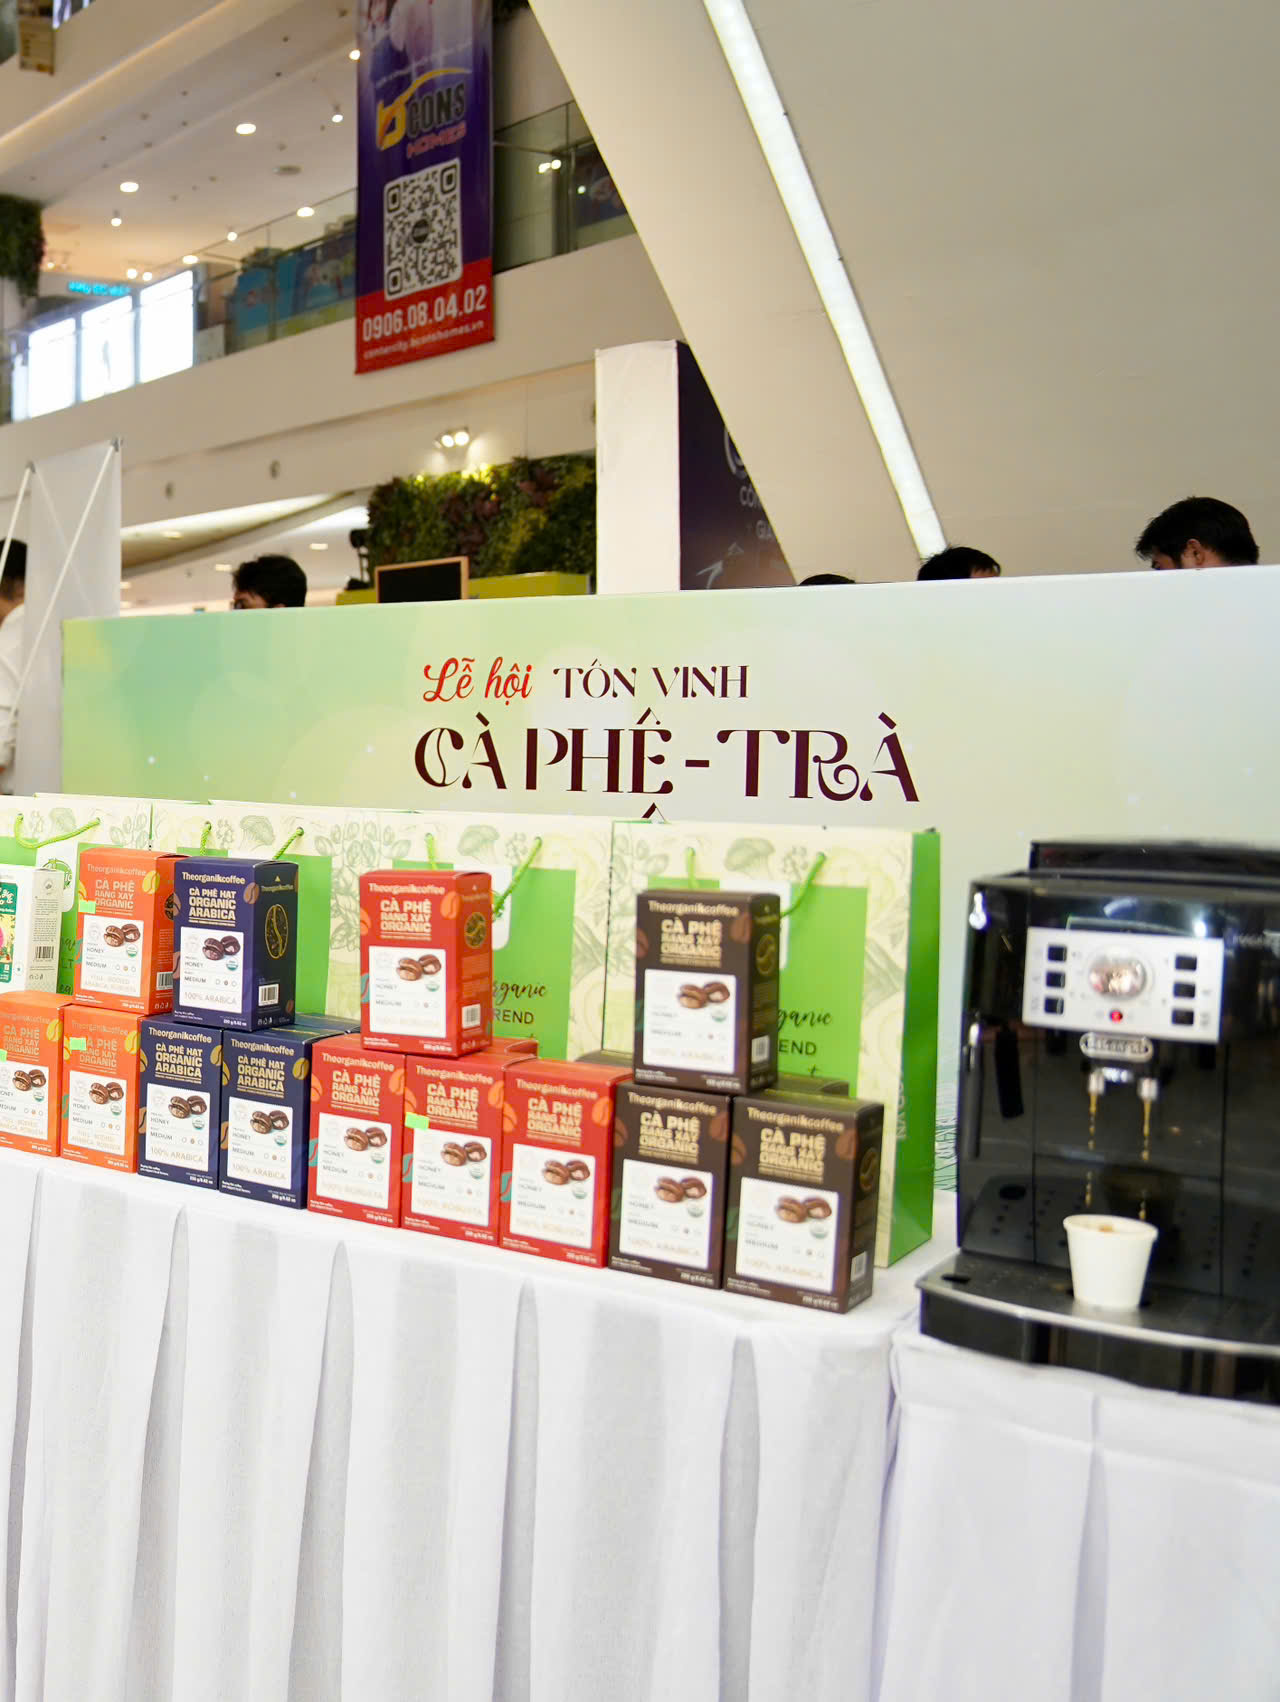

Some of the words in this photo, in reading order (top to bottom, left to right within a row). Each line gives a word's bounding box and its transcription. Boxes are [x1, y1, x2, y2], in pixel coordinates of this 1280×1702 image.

[363, 285, 487, 341] 0906.08.04.02
[423, 656, 475, 702] Lễ
[484, 656, 533, 706] hội
[553, 658, 638, 698] TÔN
[652, 665, 750, 698] VINH
[414, 711, 508, 789] CÀ
[182, 871, 246, 885] Theorganikcoffee
[189, 886, 200, 896] CÀ
[202, 887, 218, 897] PHÊ
[369, 883, 445, 895] Theorganikcoffee
[189, 896, 237, 909] ORGANIC
[380, 897, 400, 912] CÀ
[403, 899, 432, 913] PHÊ
[648, 900, 740, 917] Theorganikcoffee
[189, 906, 236, 920] ARABICA
[381, 912, 408, 922] RANG
[410, 913, 431, 923] XAY
[380, 920, 432, 933] ORGANIC
[148, 1027, 212, 1043] Theorganikcoffee
[101, 1050, 118, 1060] XAY
[155, 1042, 167, 1052] CÀ
[168, 1043, 184, 1054] PHÊ
[230, 1038, 295, 1056] Theorganikcoffee
[80, 1055, 117, 1068] ORGANIC
[155, 1052, 203, 1067] ORGANIC
[237, 1054, 249, 1065] CÀ
[250, 1055, 267, 1067] PHÊ
[322, 1053, 395, 1072] Theorganikcoffee
[155, 1062, 202, 1077] ARABICA
[237, 1064, 285, 1081] ORGANIC
[416, 1065, 493, 1084] Theorganikcoffee
[237, 1075, 284, 1092] ARABICA
[332, 1069, 350, 1084] CÀ
[354, 1071, 381, 1088] PHÊ
[332, 1084, 359, 1095] RANG
[360, 1087, 380, 1097] XAY
[427, 1082, 447, 1096] CÀ
[450, 1085, 479, 1101] PHÊ
[516, 1078, 598, 1099] Theorganikcoffee
[332, 1091, 380, 1107] ORGANIC
[427, 1095, 455, 1106] RANG
[457, 1099, 478, 1110] XAY
[528, 1096, 549, 1112] CÀ
[552, 1100, 583, 1117] PHÊ
[628, 1091, 717, 1116] Theorganikcoffee
[72, 1116, 93, 1125] MEDIUM
[427, 1104, 478, 1121] ORGANIC
[527, 1111, 558, 1122] RANG
[559, 1114, 582, 1126] XAY
[747, 1107, 844, 1133] Theorganikcoffee
[150, 1117, 169, 1125] HONEY
[527, 1120, 582, 1138] ORGANIC
[640, 1110, 664, 1128] CÀ
[667, 1115, 701, 1133] PHÊ
[150, 1131, 173, 1140] MEDIUM
[640, 1126, 673, 1139] RANG
[674, 1130, 699, 1143] XAY
[760, 1126, 786, 1145] CÀ
[789, 1132, 827, 1151] PHÊ
[639, 1135, 699, 1155] ORGANIC
[760, 1142, 795, 1157] RANG
[798, 1148, 824, 1162] XAY
[171, 1151, 203, 1162] ARABICA
[759, 1153, 824, 1173] ORGANIC
